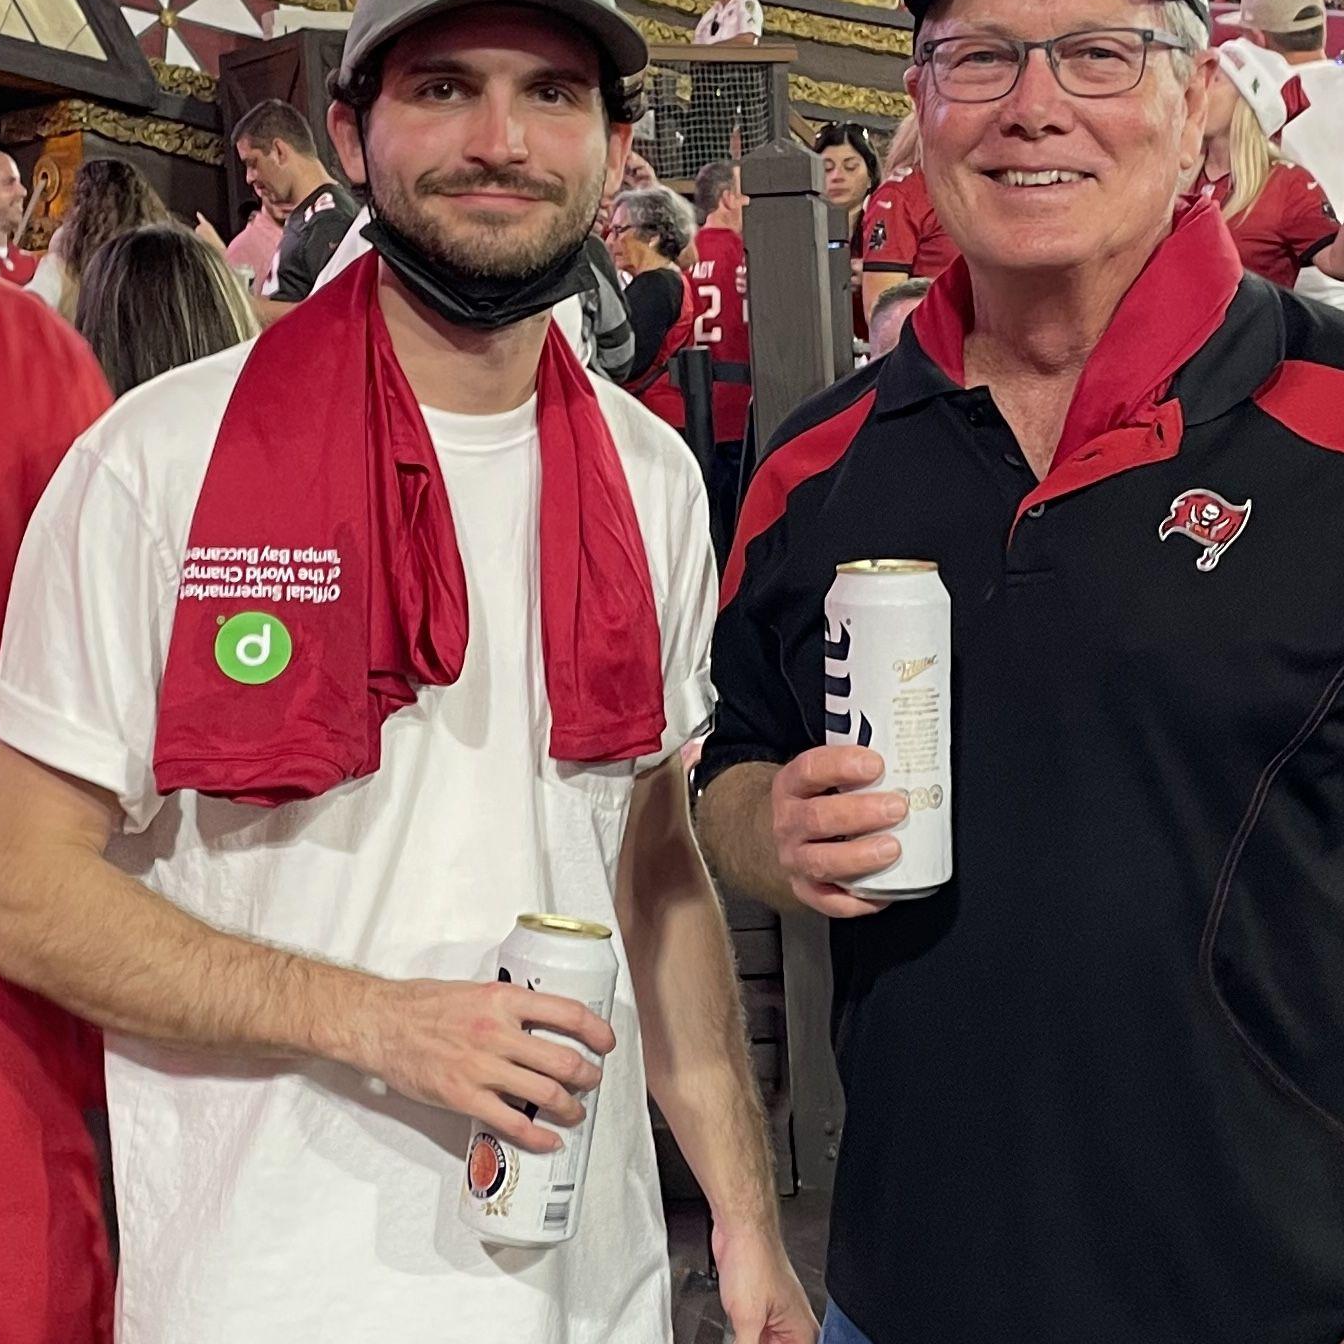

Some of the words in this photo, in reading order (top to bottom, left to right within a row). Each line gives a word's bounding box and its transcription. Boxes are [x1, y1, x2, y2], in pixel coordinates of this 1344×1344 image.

[260, 545, 292, 565] Bay
[293, 547, 342, 565] Tampa
[181, 563, 243, 583] Champ
[246, 566, 295, 583] World
[297, 568, 325, 585] the
[326, 566, 342, 585] of
[286, 584, 342, 604] Official
